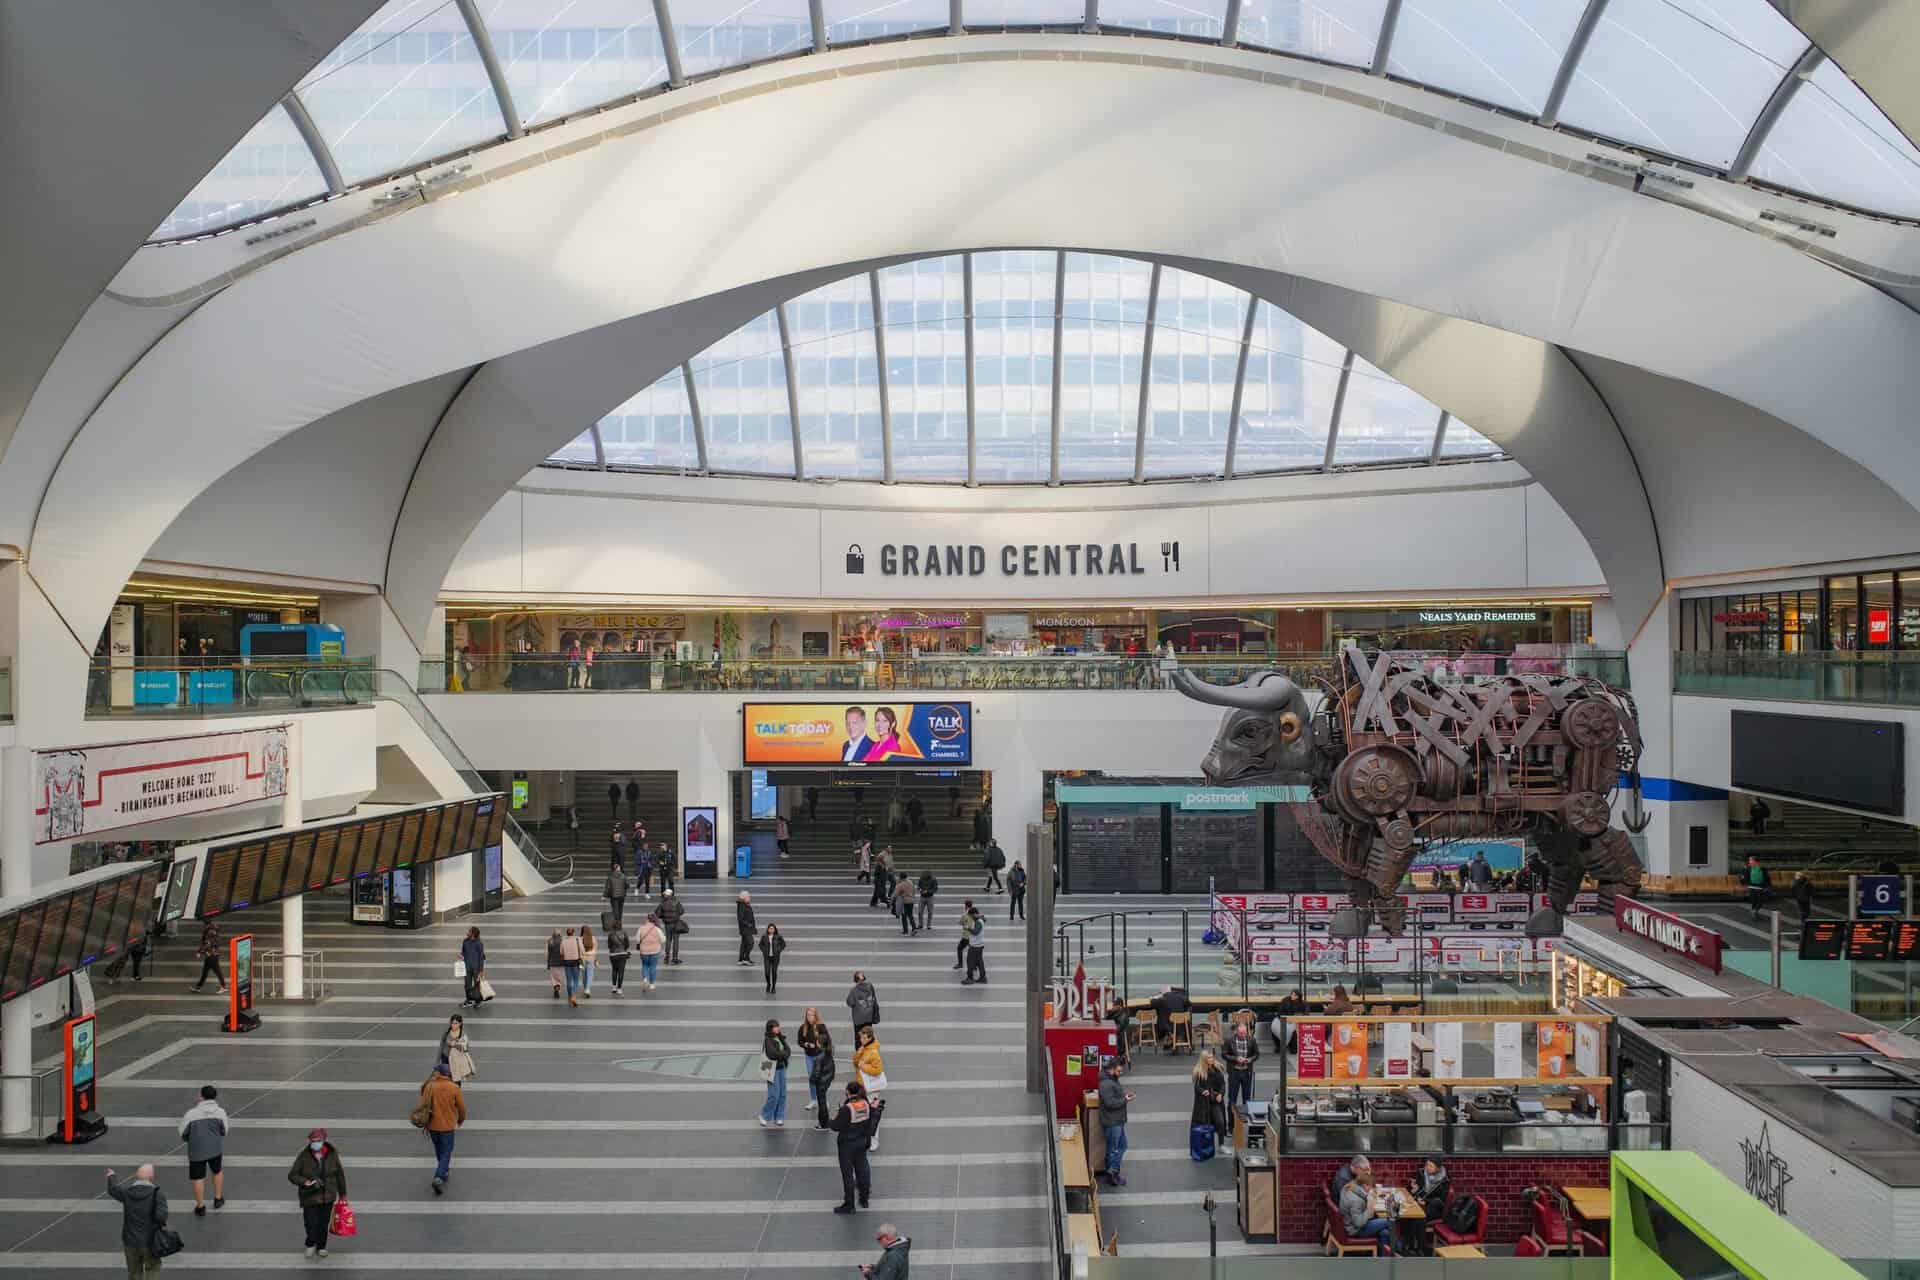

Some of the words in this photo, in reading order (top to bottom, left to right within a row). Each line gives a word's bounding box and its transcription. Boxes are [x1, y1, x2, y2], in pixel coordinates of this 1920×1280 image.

[880, 544, 986, 577] GRAND
[1001, 543, 1145, 577] CENTRAL
[1036, 617, 1095, 626] MONSOON
[1419, 612, 1453, 621] NEAL'S
[1454, 612, 1482, 621] YARD
[1484, 611, 1536, 621] REMEDIES
[756, 723, 787, 734] TALK
[789, 722, 832, 734] TODAY
[928, 716, 961, 728] TALK
[142, 778, 174, 793] WELCOME
[176, 775, 195, 788] HOME
[121, 792, 176, 813] BIRMINGHAM'S
[176, 787, 217, 804] MECHANICAL
[218, 783, 235, 796] BULL
[1186, 792, 1249, 806] postmark
[1875, 884, 1890, 903] 6
[1051, 976, 1109, 1019] PRET
